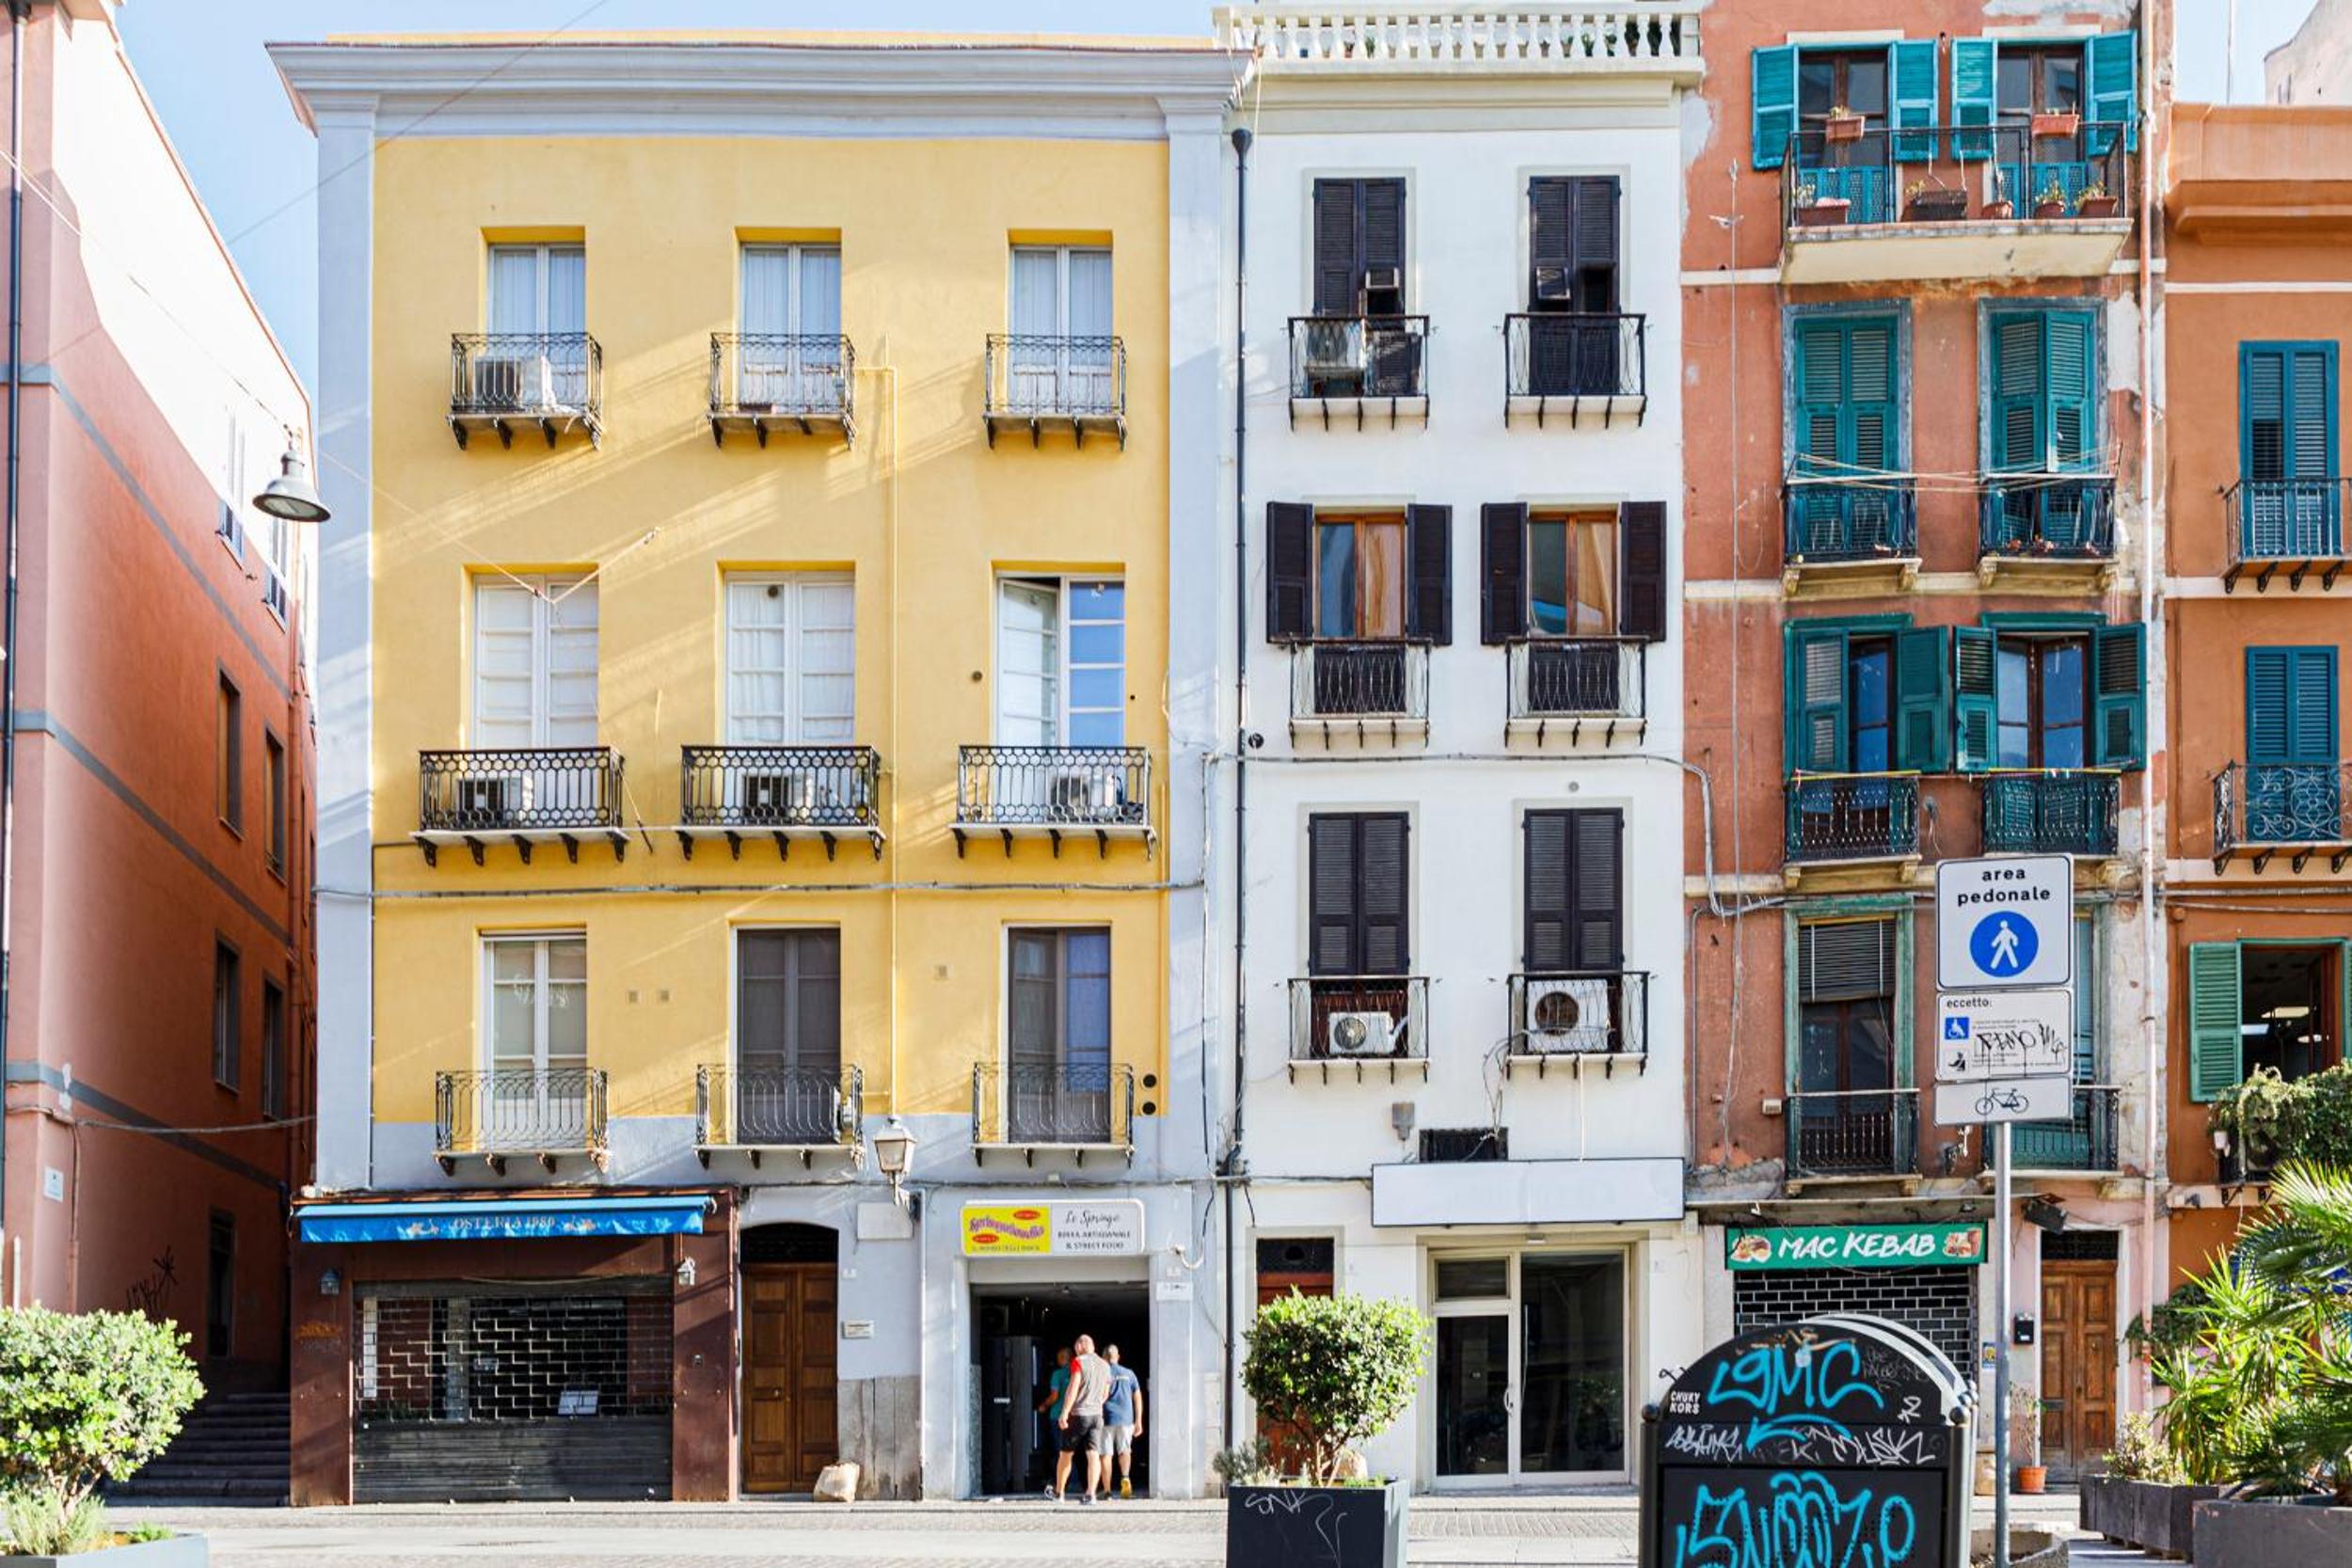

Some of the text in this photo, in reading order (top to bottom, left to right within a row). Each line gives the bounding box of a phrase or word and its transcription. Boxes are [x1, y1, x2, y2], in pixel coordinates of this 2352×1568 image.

[1981, 869, 2026, 881] area
[1957, 886, 2051, 907] pedonale
[453, 1217, 522, 1229] OSTERIA
[1073, 1242, 1100, 1250] STREET
[1102, 1242, 1124, 1250] FOOD
[1778, 1231, 1936, 1259] MAC KEBAB
[1669, 1402, 1700, 1415] KORS
